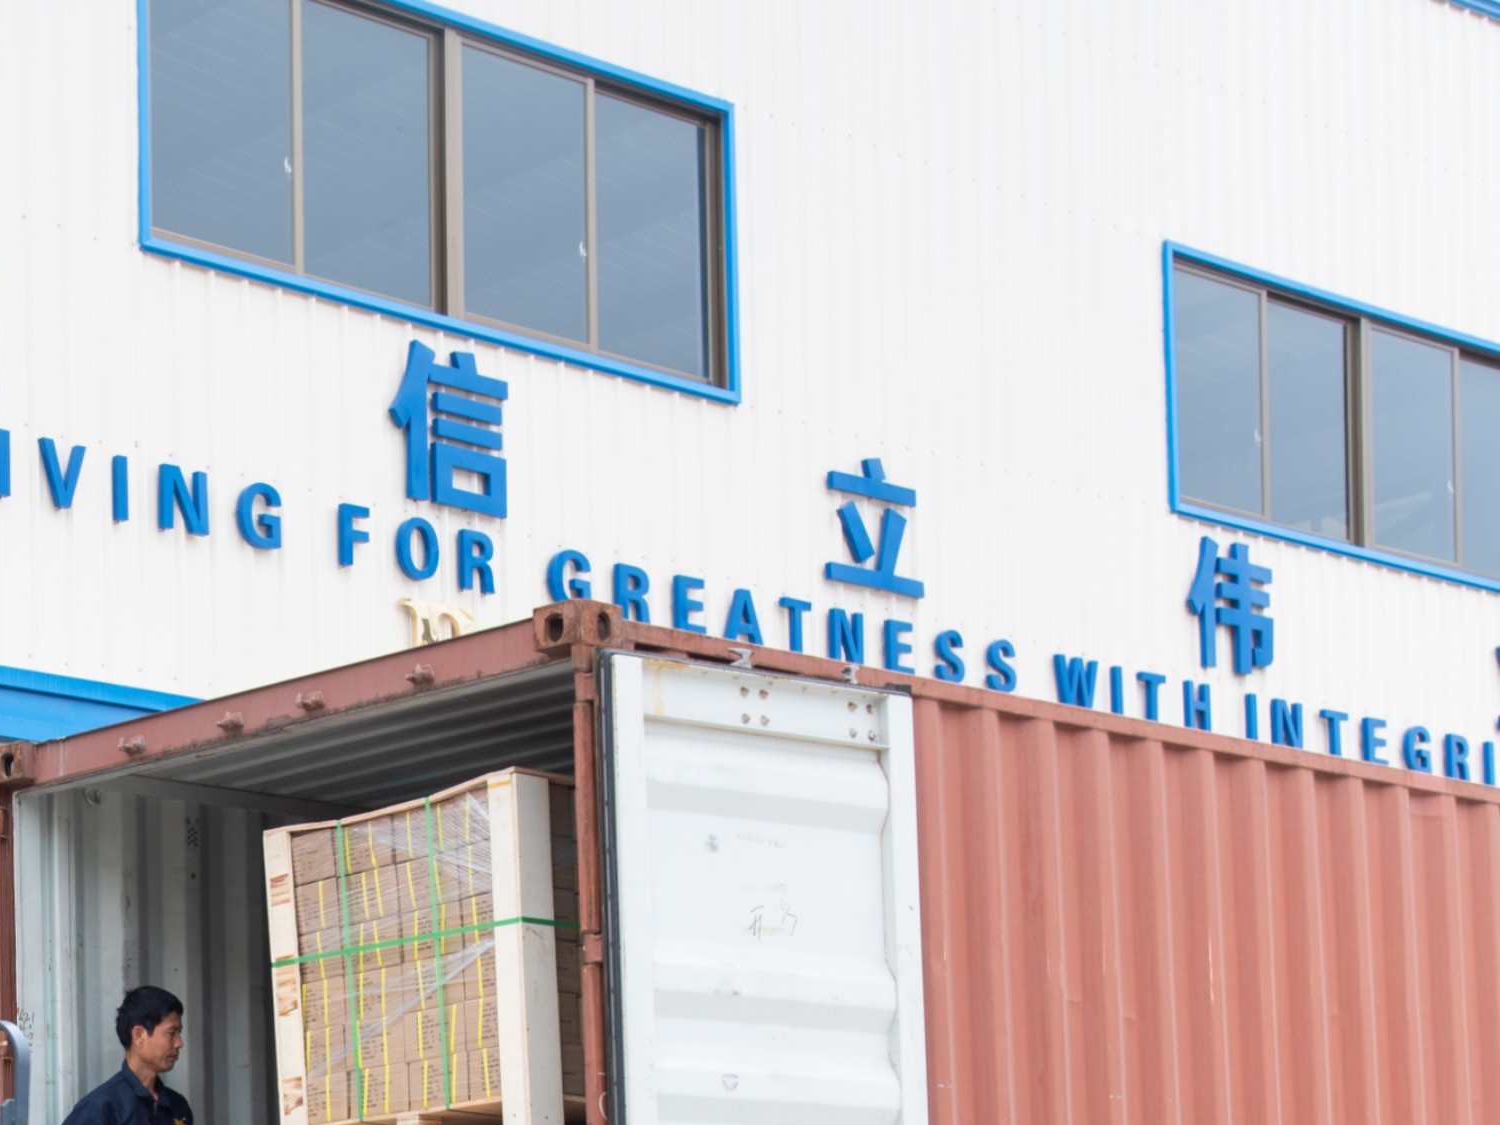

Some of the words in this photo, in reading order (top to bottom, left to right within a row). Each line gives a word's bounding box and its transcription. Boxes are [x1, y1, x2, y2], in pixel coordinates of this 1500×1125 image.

[337, 503, 496, 595] FOR
[546, 549, 1017, 695] GREATNESS
[1053, 654, 1212, 732] WITH
